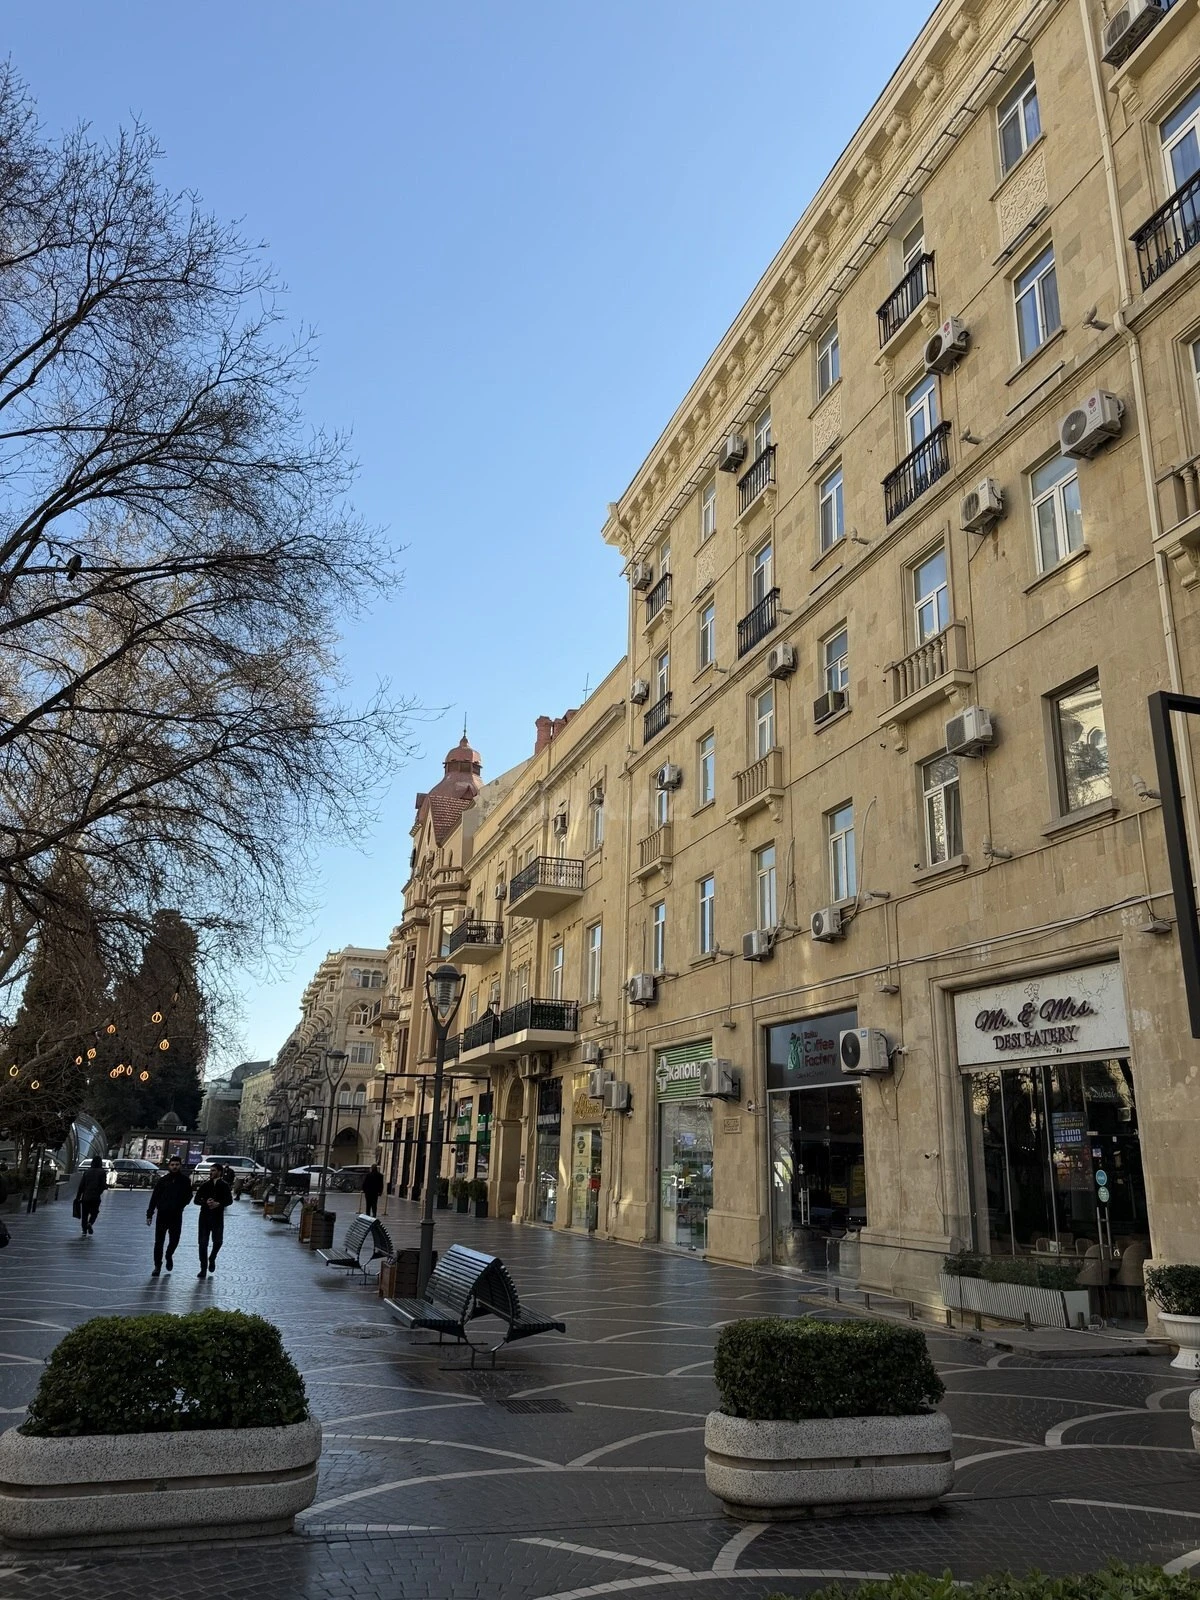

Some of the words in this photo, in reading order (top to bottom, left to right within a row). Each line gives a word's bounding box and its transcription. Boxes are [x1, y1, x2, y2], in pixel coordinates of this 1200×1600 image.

[975, 1009, 1014, 1031] Mr.
[1017, 1002, 1035, 1027] &
[1040, 996, 1095, 1022] Mrs.
[993, 1033, 1024, 1049] DESI
[1024, 1025, 1078, 1046] EATERY
[804, 1053, 837, 1067] Factory
